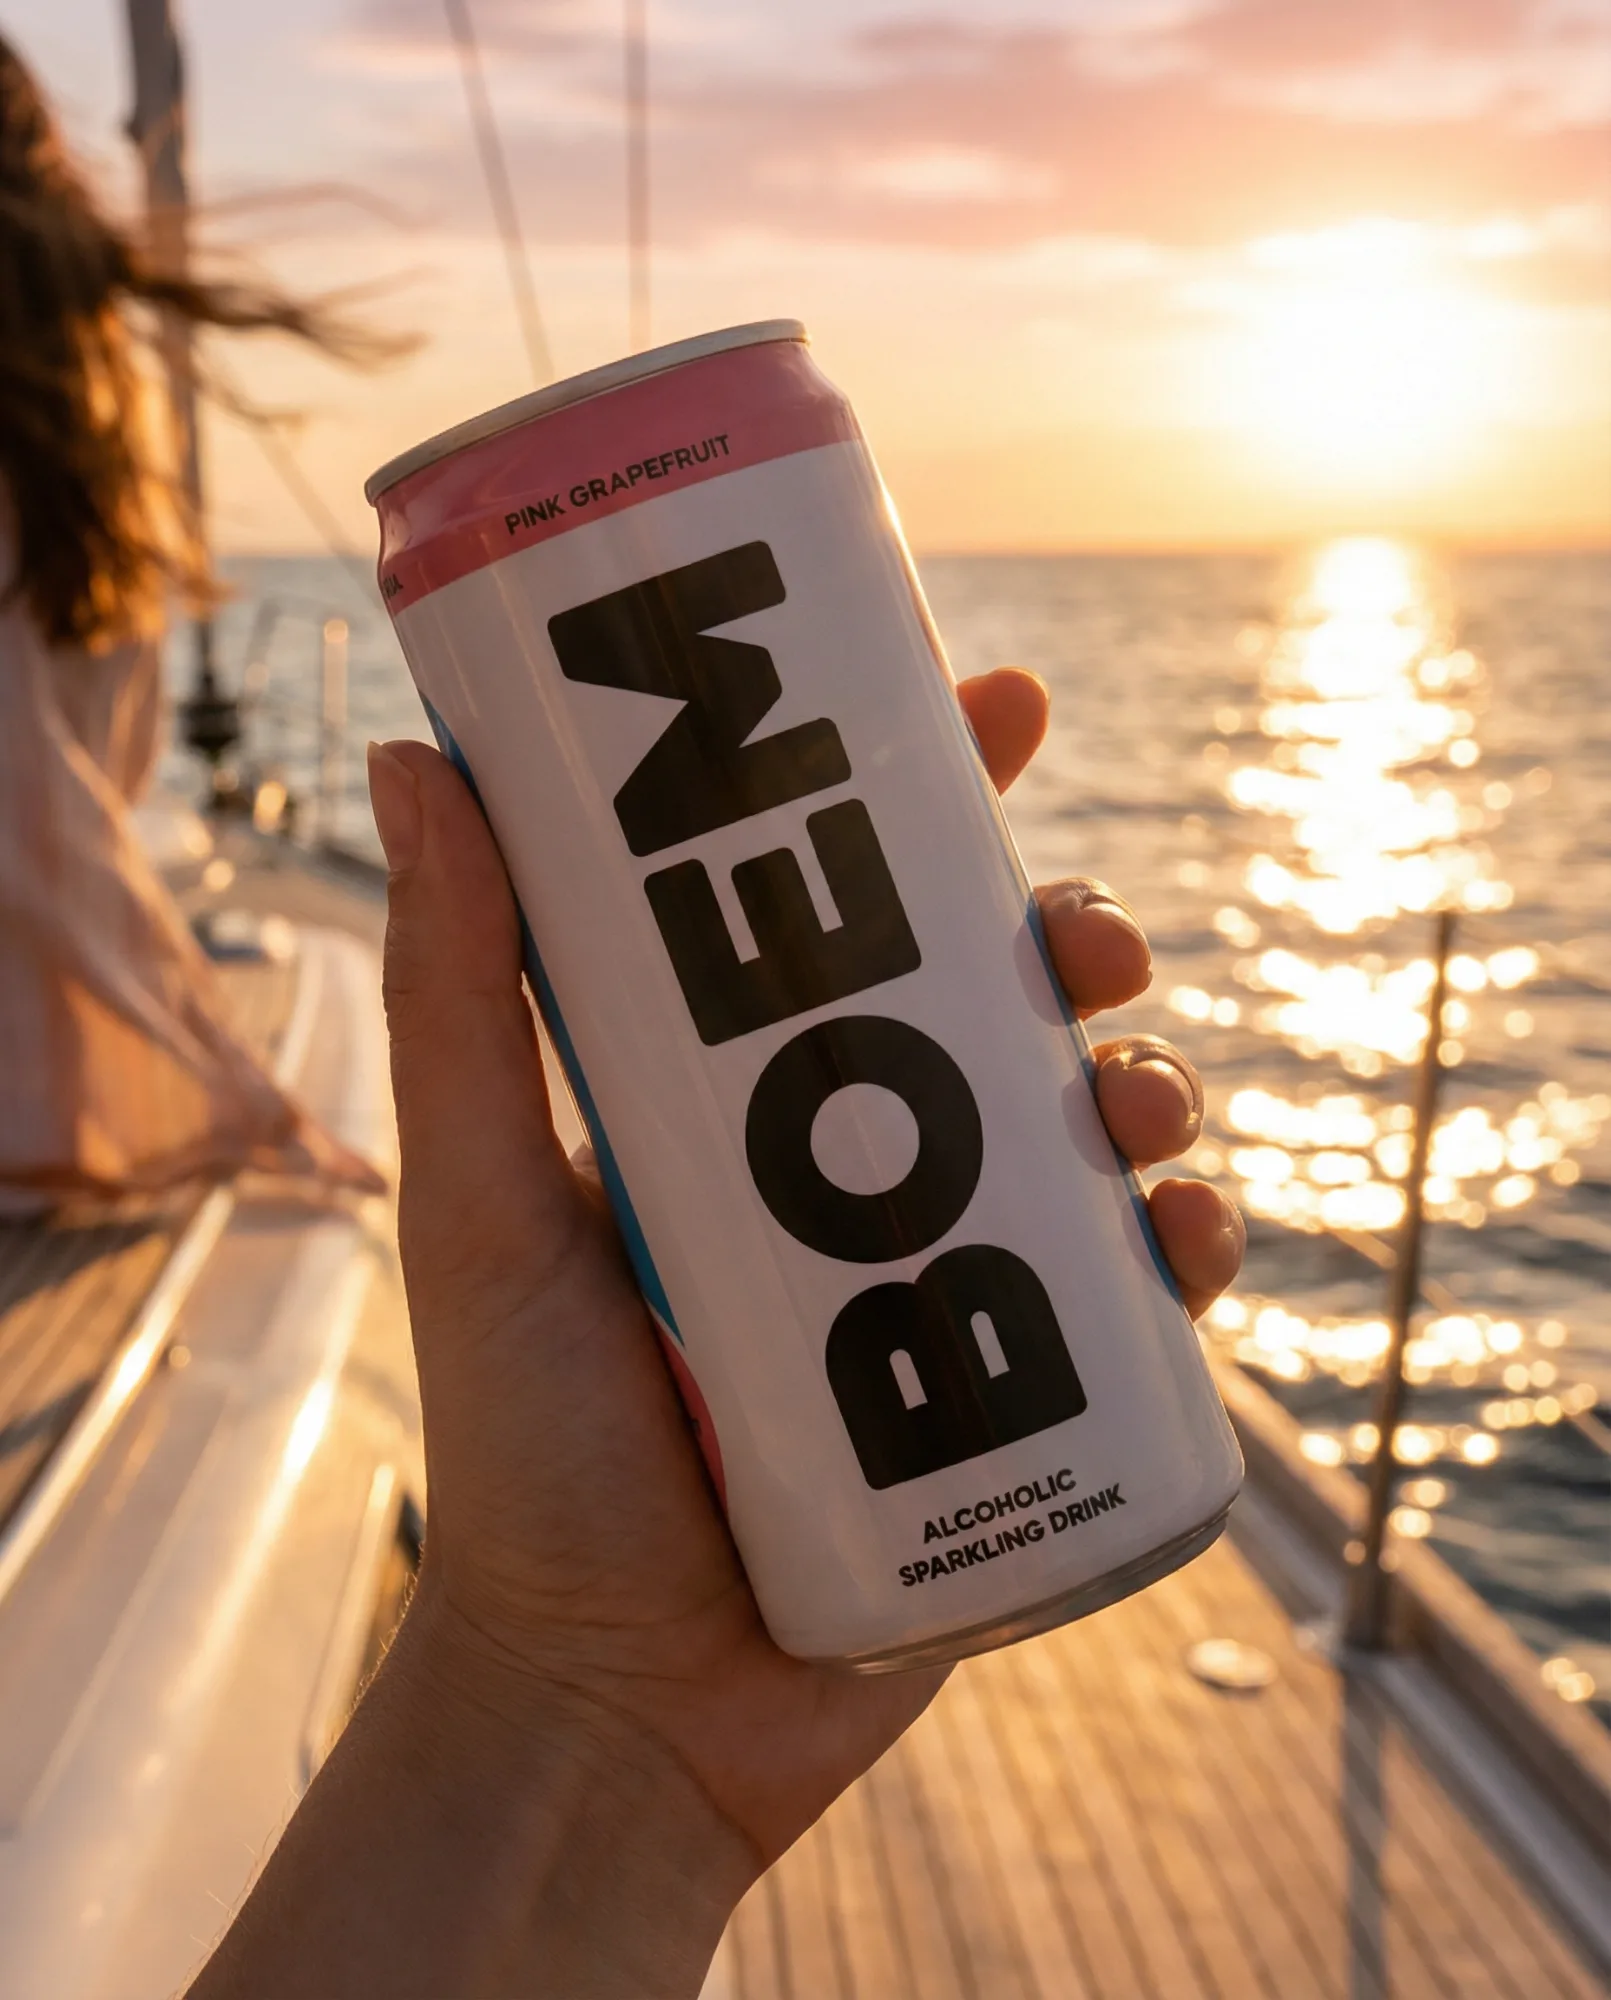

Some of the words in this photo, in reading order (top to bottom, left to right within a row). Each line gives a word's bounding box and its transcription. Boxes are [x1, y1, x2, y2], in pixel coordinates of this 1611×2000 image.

[504, 494, 567, 536] PINK
[568, 434, 730, 508] GRAPEFRUIT
[547, 540, 1088, 1491] BOEM
[898, 1520, 1045, 1587] SPARKLING
[1047, 1483, 1127, 1534] DRINK
[924, 1468, 1077, 1544] ALCOHOLIC
